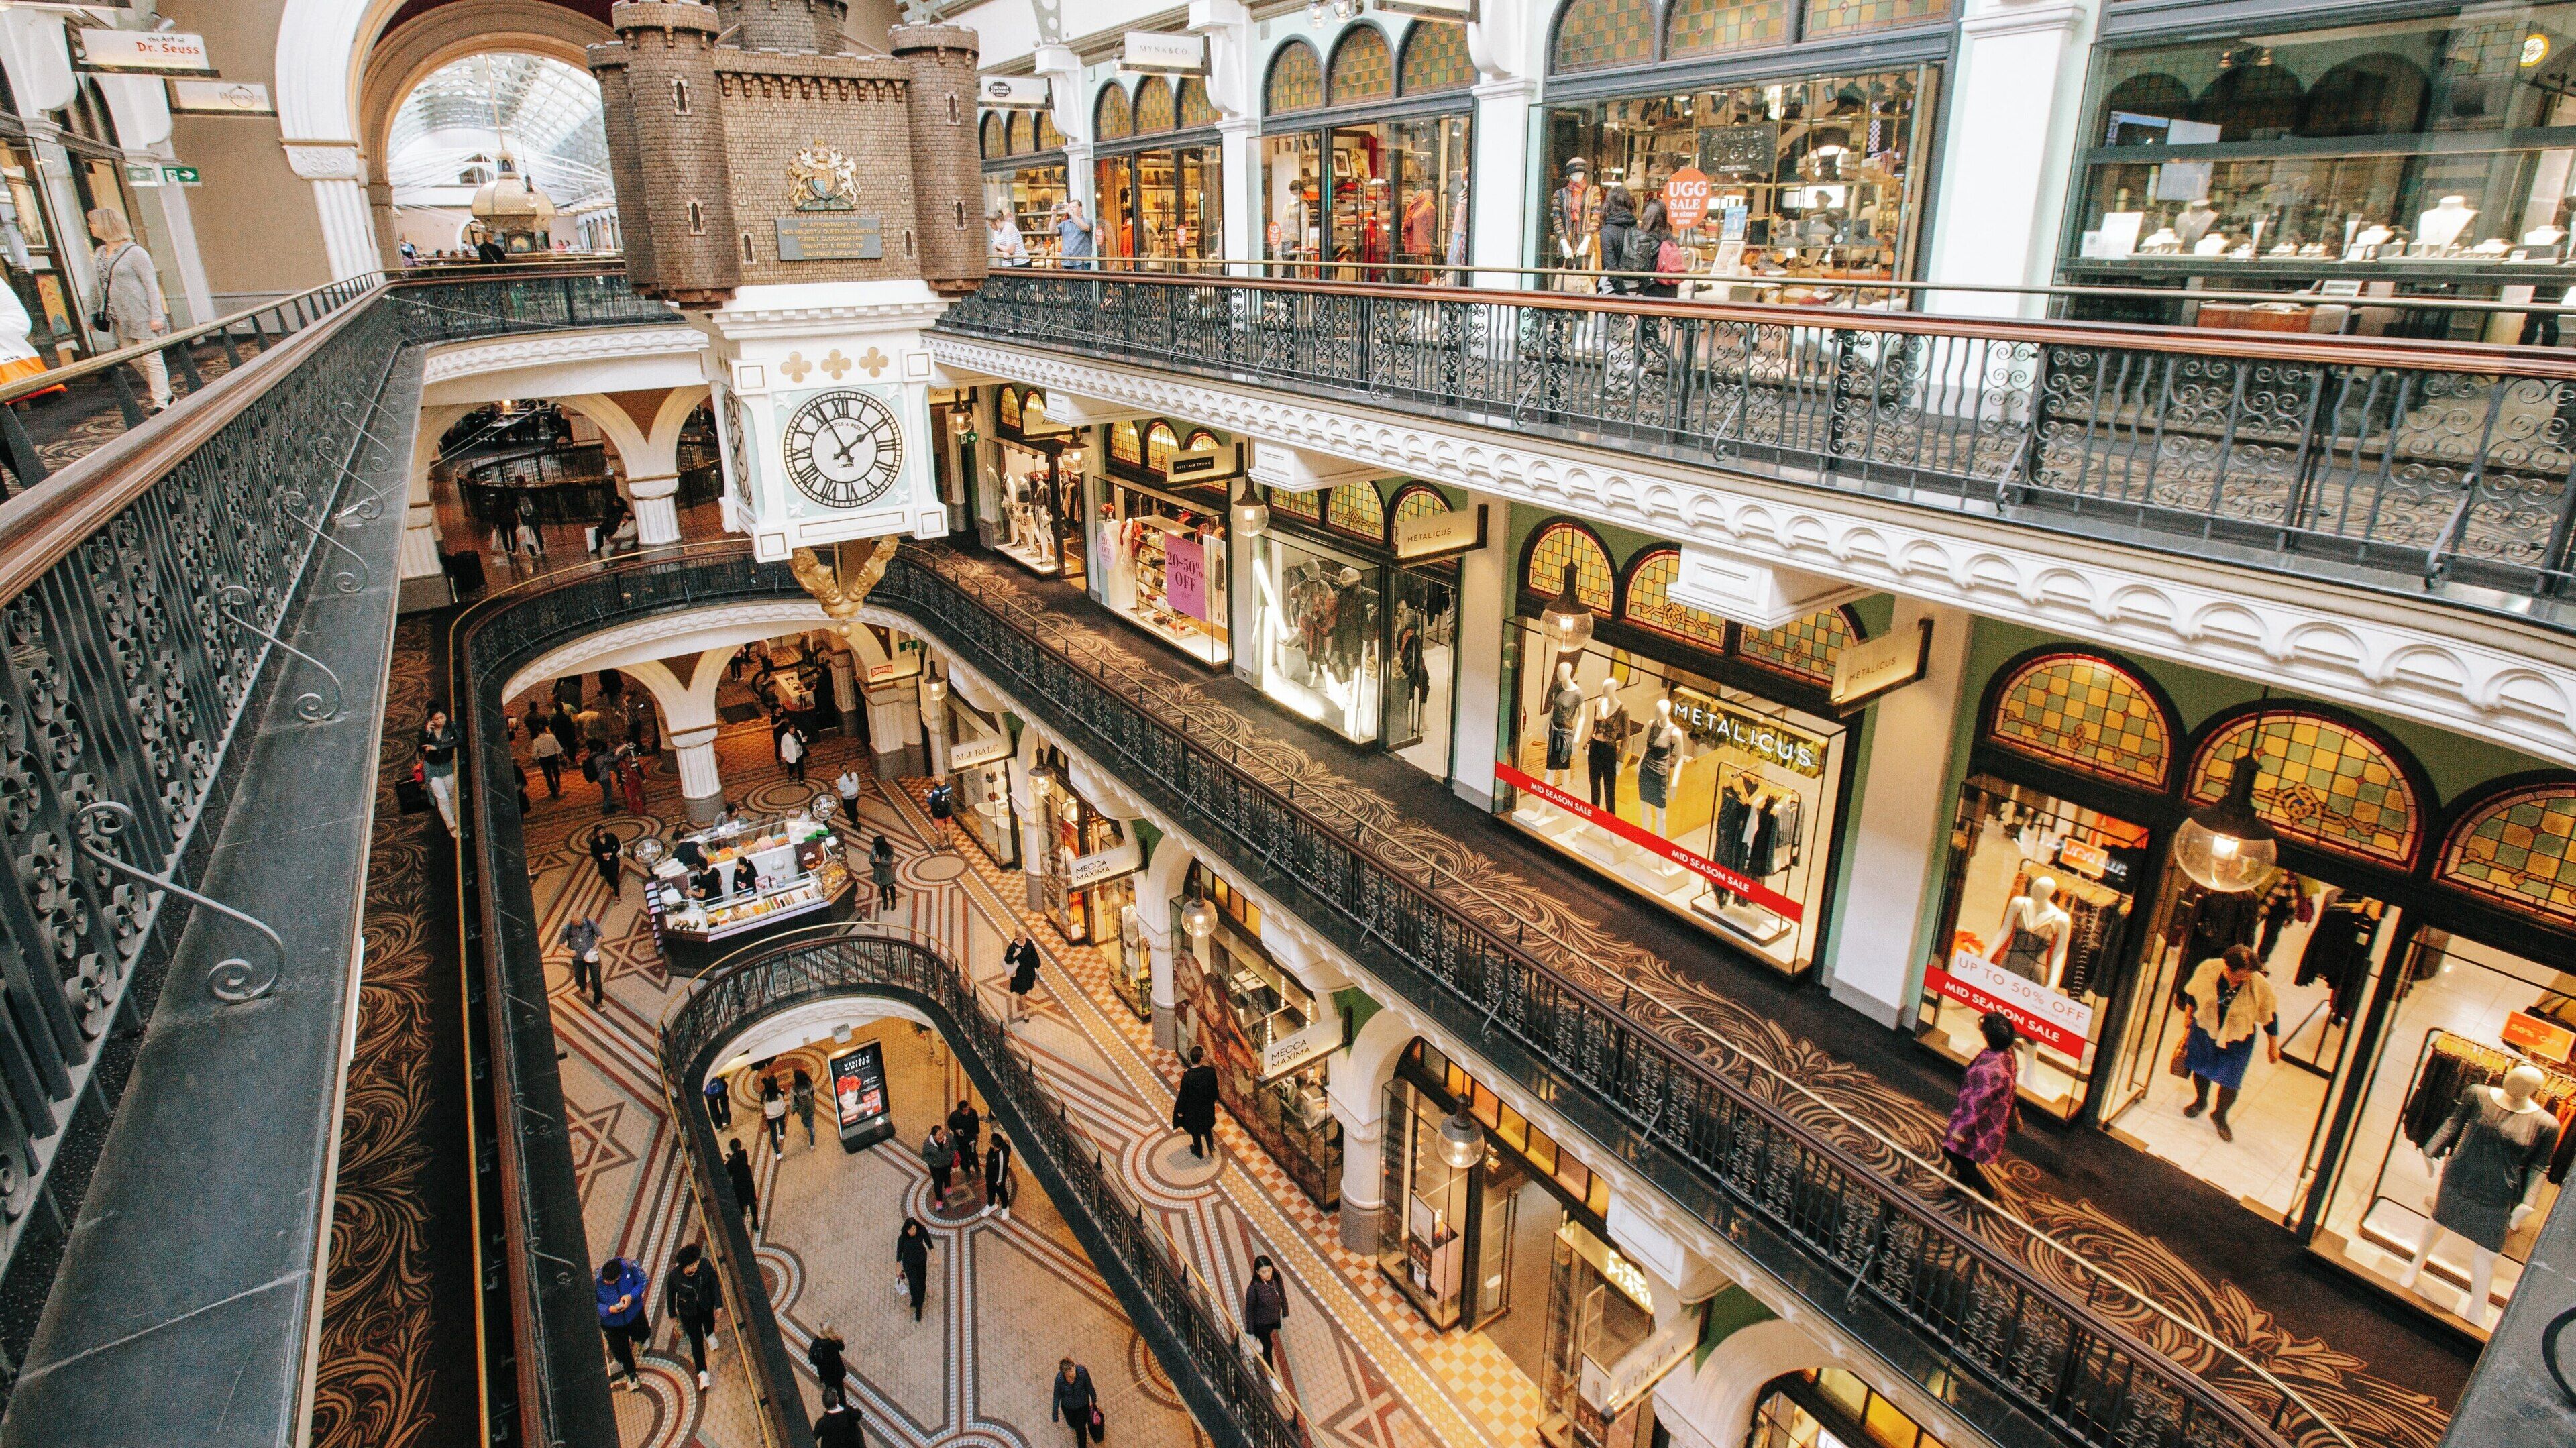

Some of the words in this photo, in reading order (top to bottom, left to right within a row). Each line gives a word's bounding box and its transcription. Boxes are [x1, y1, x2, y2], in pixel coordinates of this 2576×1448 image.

[136, 42, 157, 51] Dr.
[162, 44, 199, 54] Seuss
[1140, 45, 1190, 54] MYNK&CO.
[1668, 180, 1707, 197] UGG
[1670, 199, 1701, 210] SALE
[1407, 528, 1452, 542] METALICUS
[1175, 572, 1195, 592] OFF
[1849, 657, 1896, 681] METALICUS
[1674, 703, 1815, 767] METALICUS
[975, 744, 998, 756] BALE
[812, 801, 837, 812] ZUMBO
[1530, 782, 1544, 794] MID
[1545, 789, 1574, 808] SEASON
[1574, 803, 1593, 817] SALE
[635, 845, 662, 856] ZUMBO
[1076, 860, 1107, 874] MECCA
[1076, 867, 1111, 881] MAXIMA
[1671, 849, 1688, 862] MID
[1690, 858, 1726, 881] SEASON
[1727, 876, 1750, 893] SALE
[1957, 957, 1978, 972] UP
[1985, 968, 2004, 986] TO
[2010, 982, 2045, 1005] 50%
[2052, 1001, 2085, 1021] OFF
[1944, 981, 1970, 998] MID
[2027, 1020, 2060, 1042] SALE
[2510, 1023, 2535, 1038] 50%
[2538, 1035, 2562, 1047] OFF
[1271, 1039, 1307, 1061] MECCA
[844, 1055, 869, 1067] VISIBLY
[845, 1059, 870, 1072] WHITER
[1272, 1046, 1311, 1070] MAXIMA
